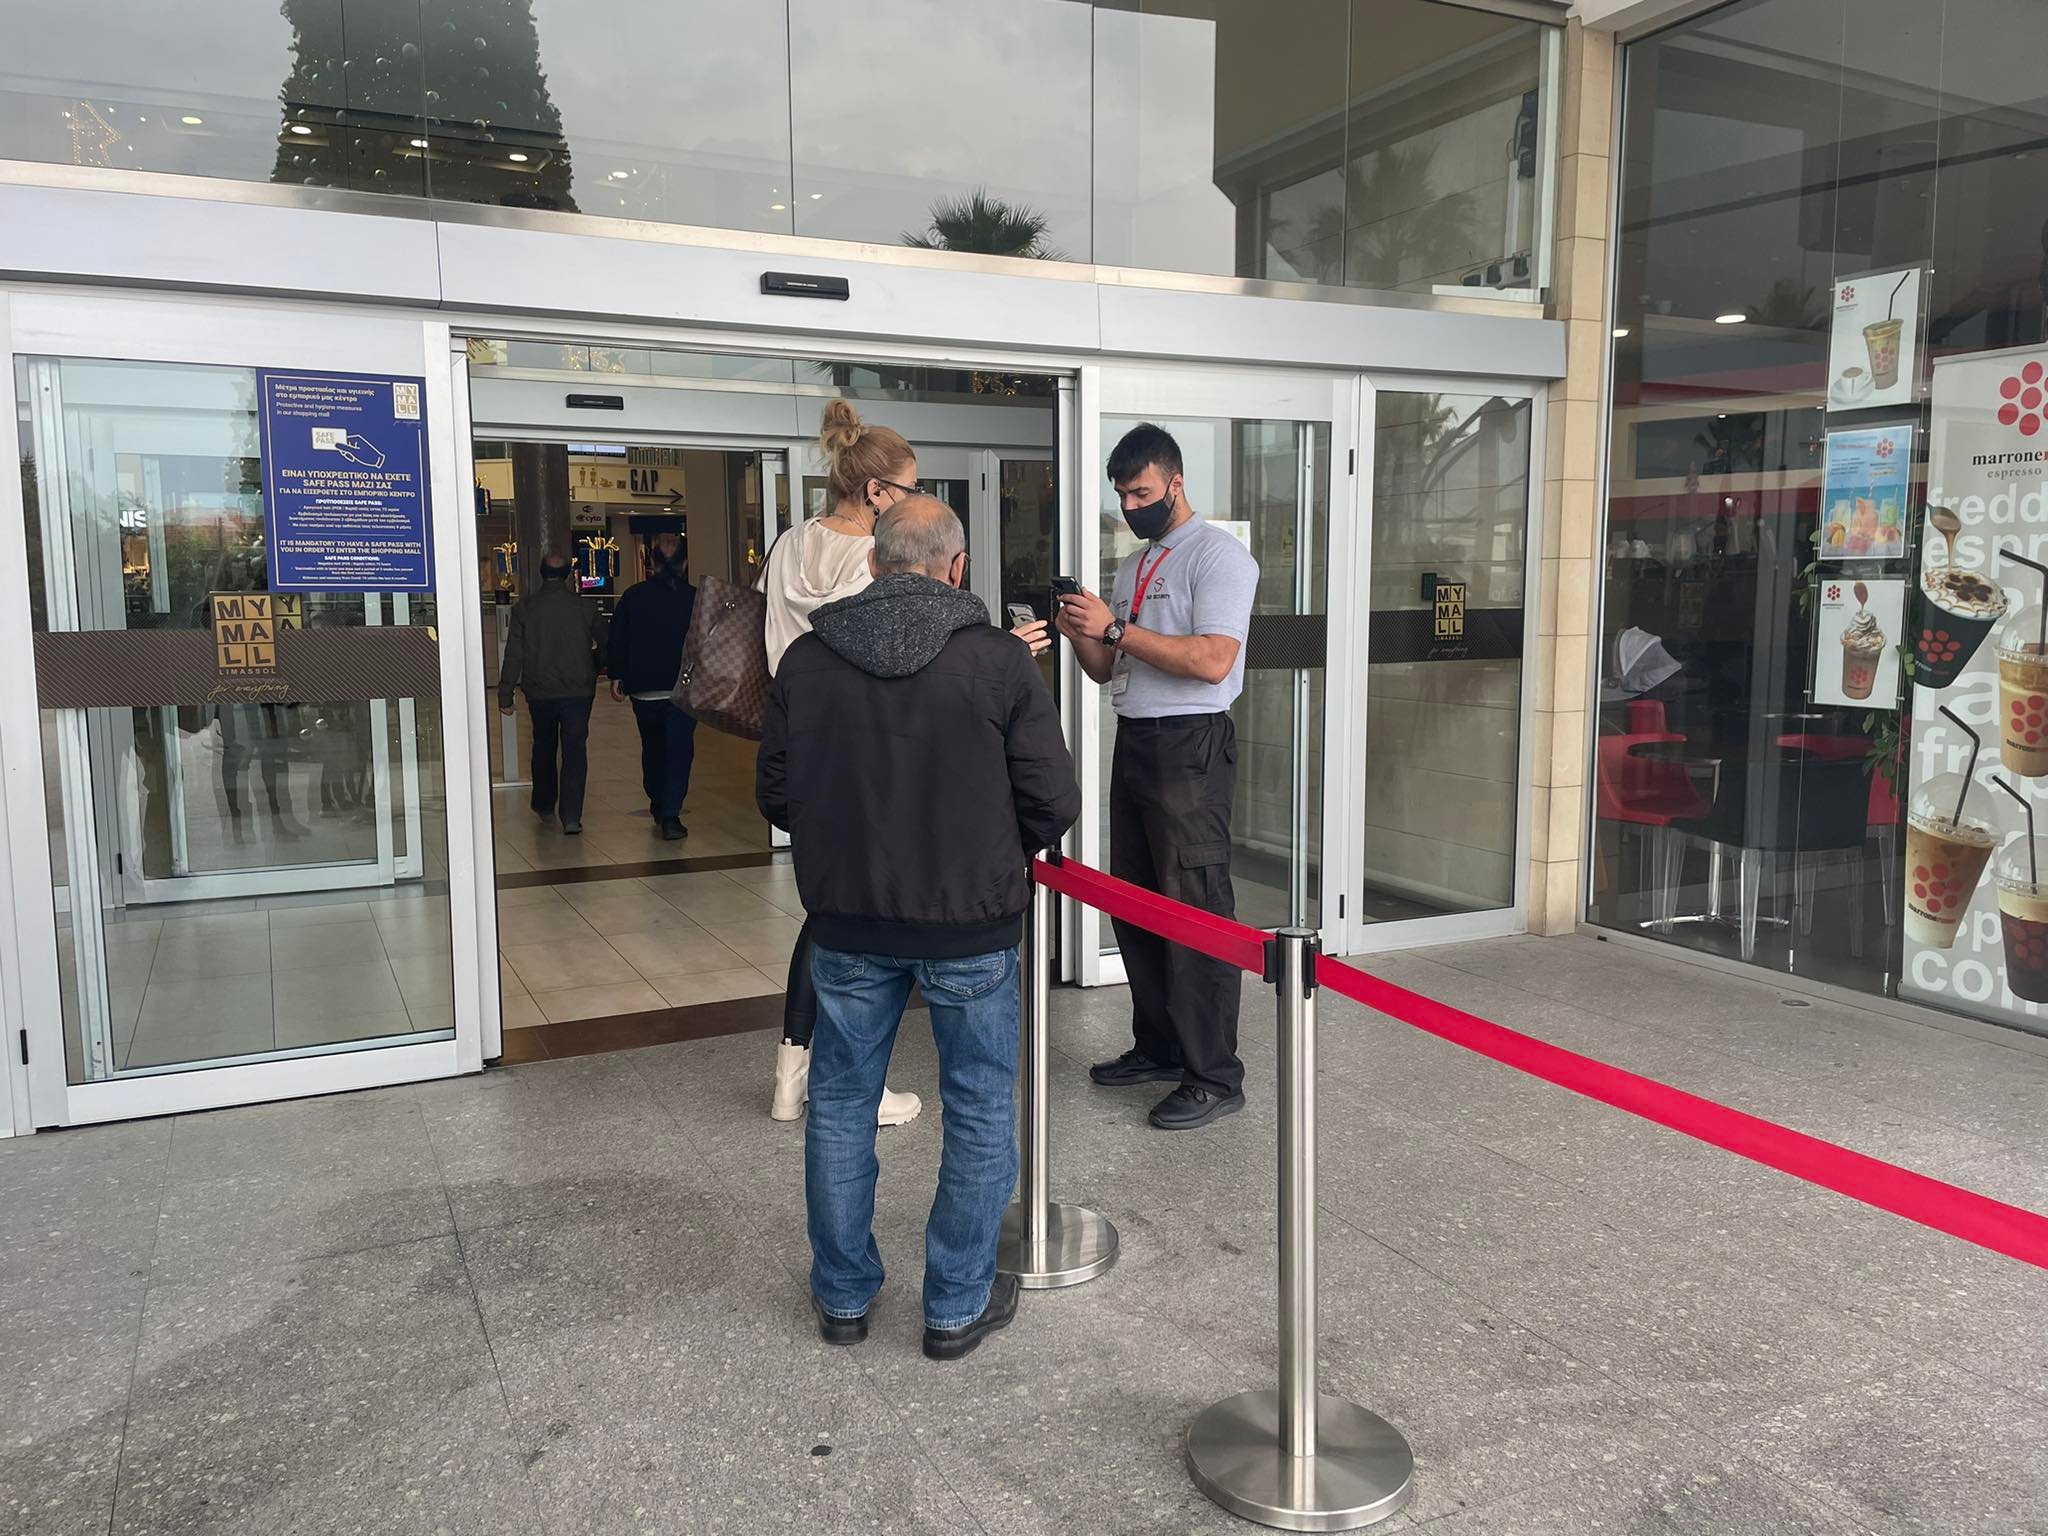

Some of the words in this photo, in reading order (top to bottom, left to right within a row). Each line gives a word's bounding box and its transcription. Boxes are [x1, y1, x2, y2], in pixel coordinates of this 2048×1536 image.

[281, 469, 305, 477] ΕΙΝΑΙ
[307, 470, 369, 480] ΥΠΟΧΡΕΩΤΙΚΟ
[385, 473, 411, 481] ΕΧΕΤΕ
[630, 469, 659, 492] GAP
[1987, 467, 2042, 480] espresso
[303, 479, 325, 487] SAFE
[327, 480, 350, 488] PASS
[376, 481, 392, 489] ΣΑΣ
[1437, 587, 1462, 601] MY
[216, 598, 266, 619] MY
[1438, 604, 1461, 618] MA
[221, 622, 269, 645] MA
[1438, 620, 1461, 633] LL
[223, 646, 271, 665] LL
[219, 668, 276, 676] LIMASSOL
[235, 680, 290, 701] everything
